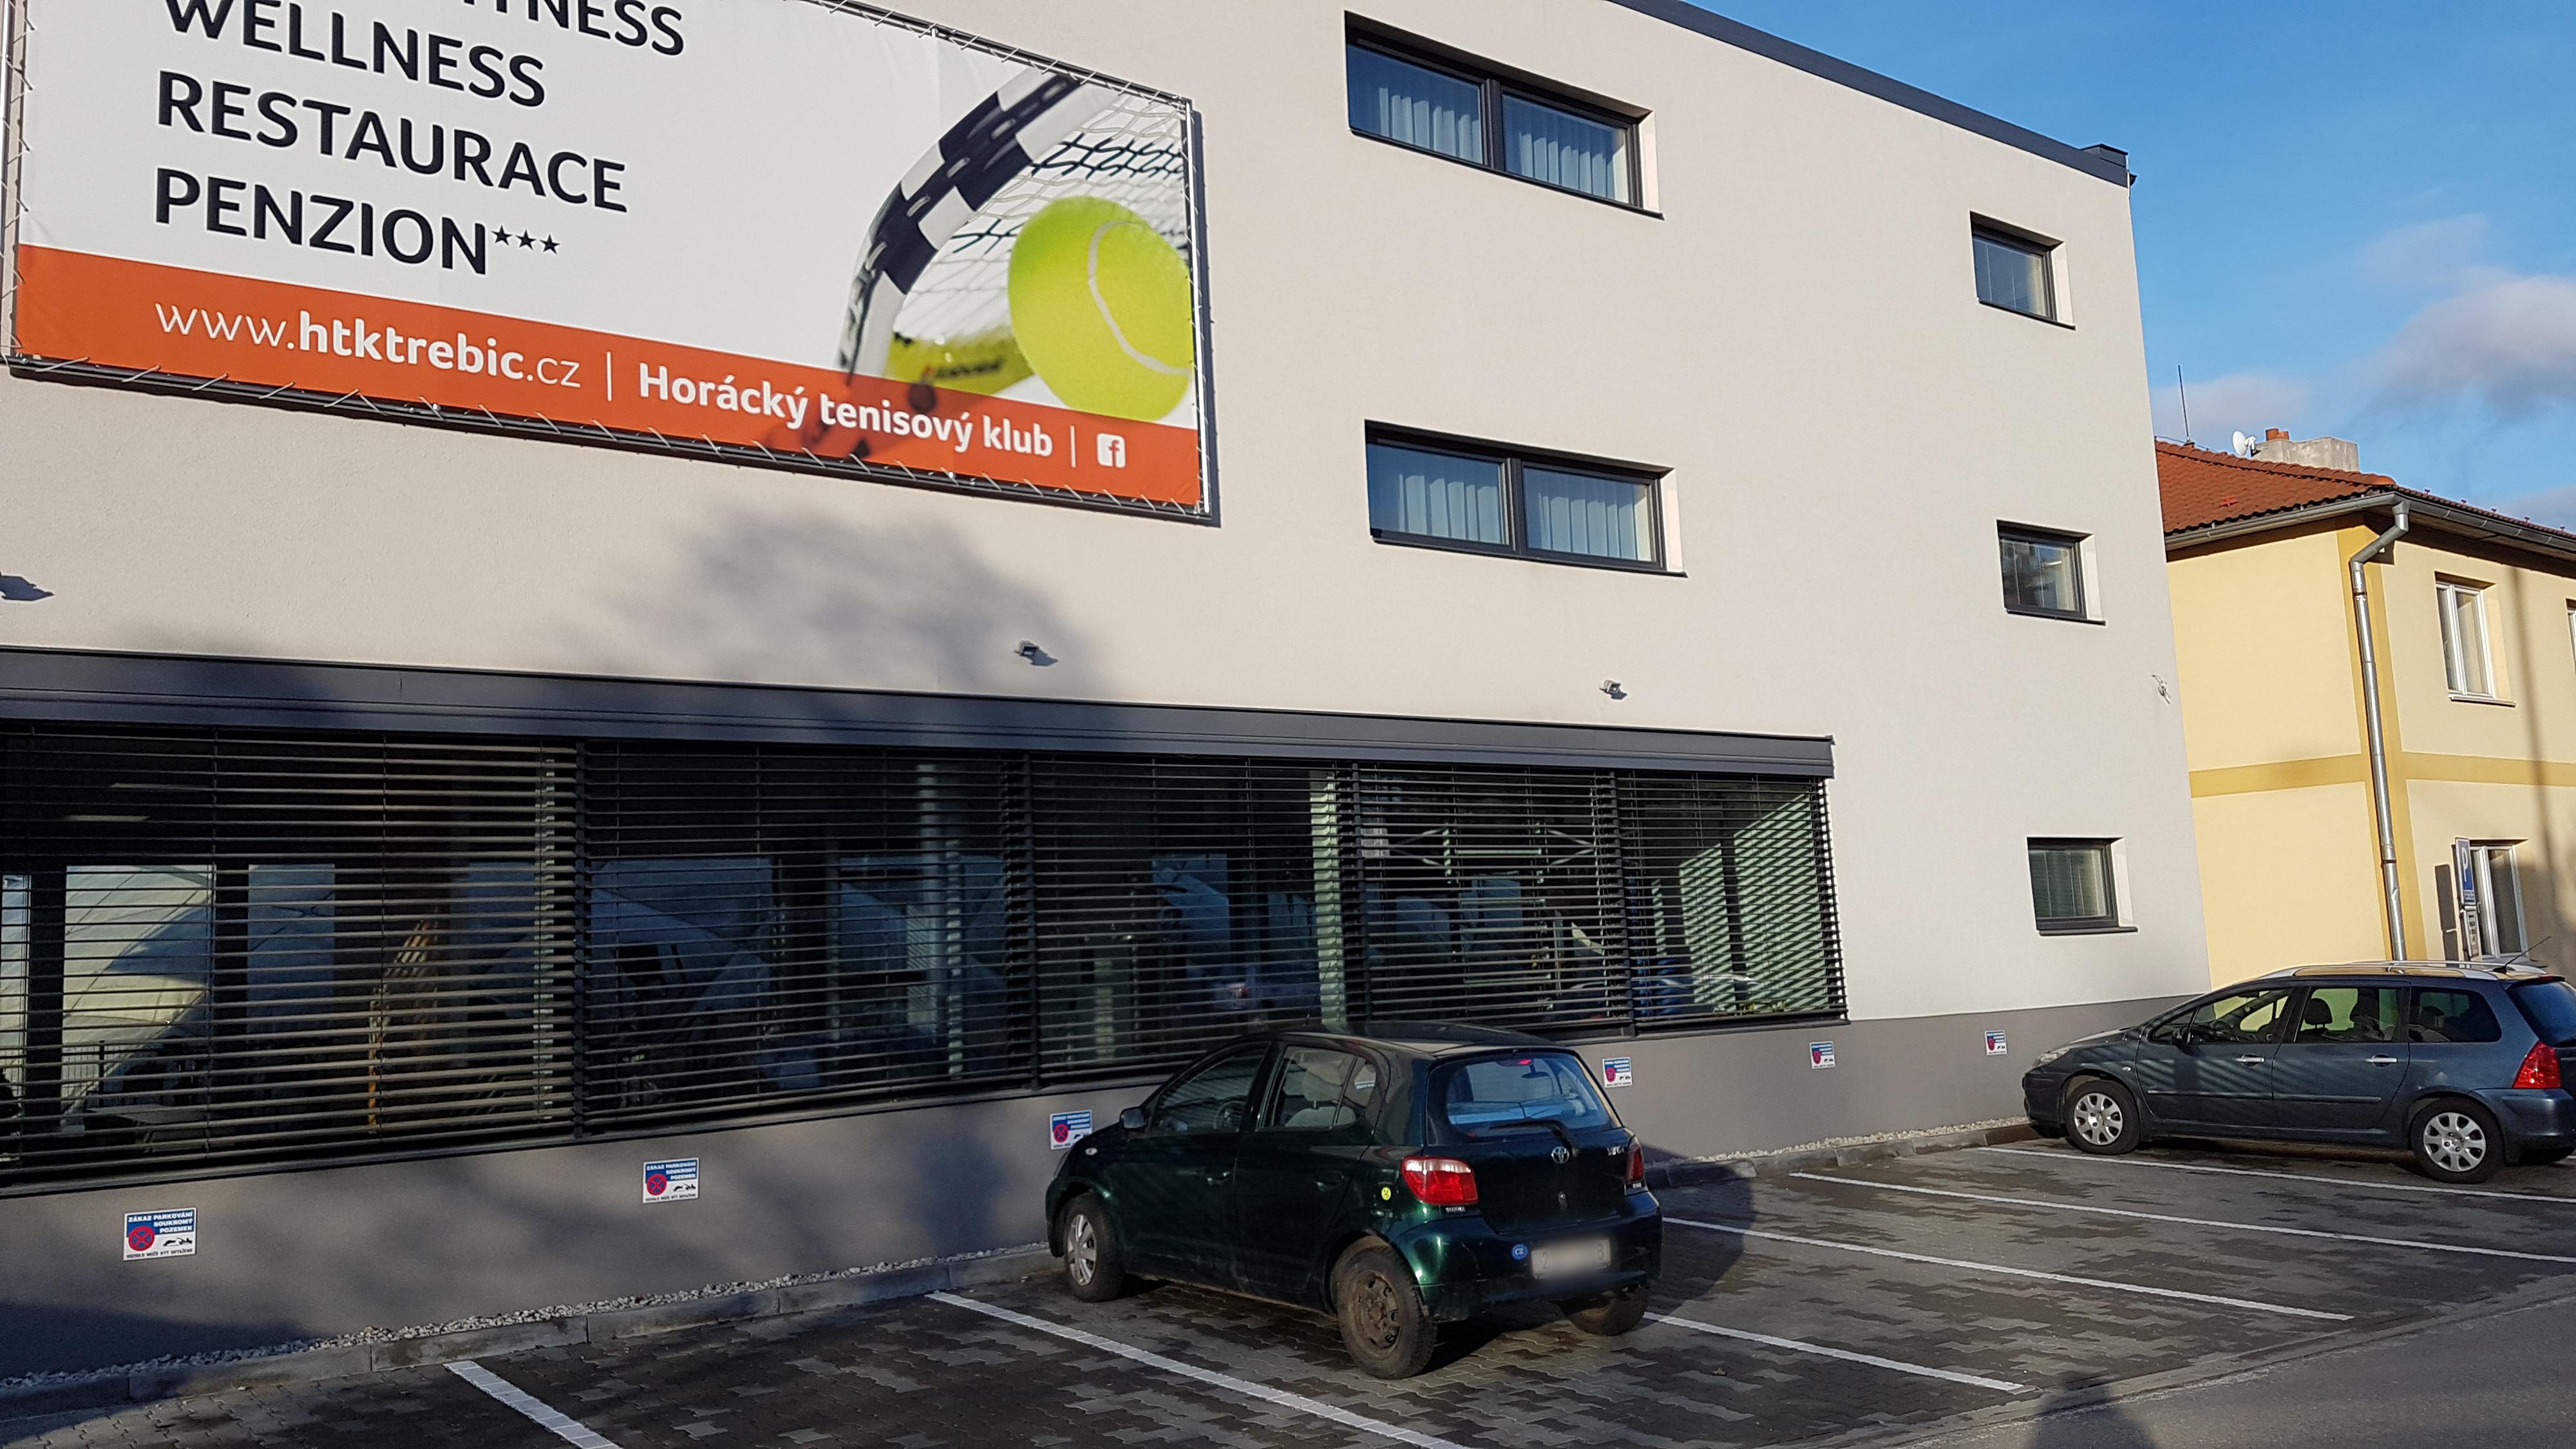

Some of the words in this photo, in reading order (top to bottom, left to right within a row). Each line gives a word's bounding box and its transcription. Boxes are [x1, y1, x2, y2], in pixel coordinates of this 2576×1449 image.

[166, 0, 545, 107] WELLNESS
[158, 70, 627, 213] RESTAURACE
[155, 303, 581, 388] www.htktrebic.cz
[639, 363, 808, 430] Horácký
[820, 393, 973, 453] tenisový
[983, 415, 1053, 457] klub
[2461, 846, 2468, 882] P
[154, 1211, 193, 1220] PARKOVÁNÍ
